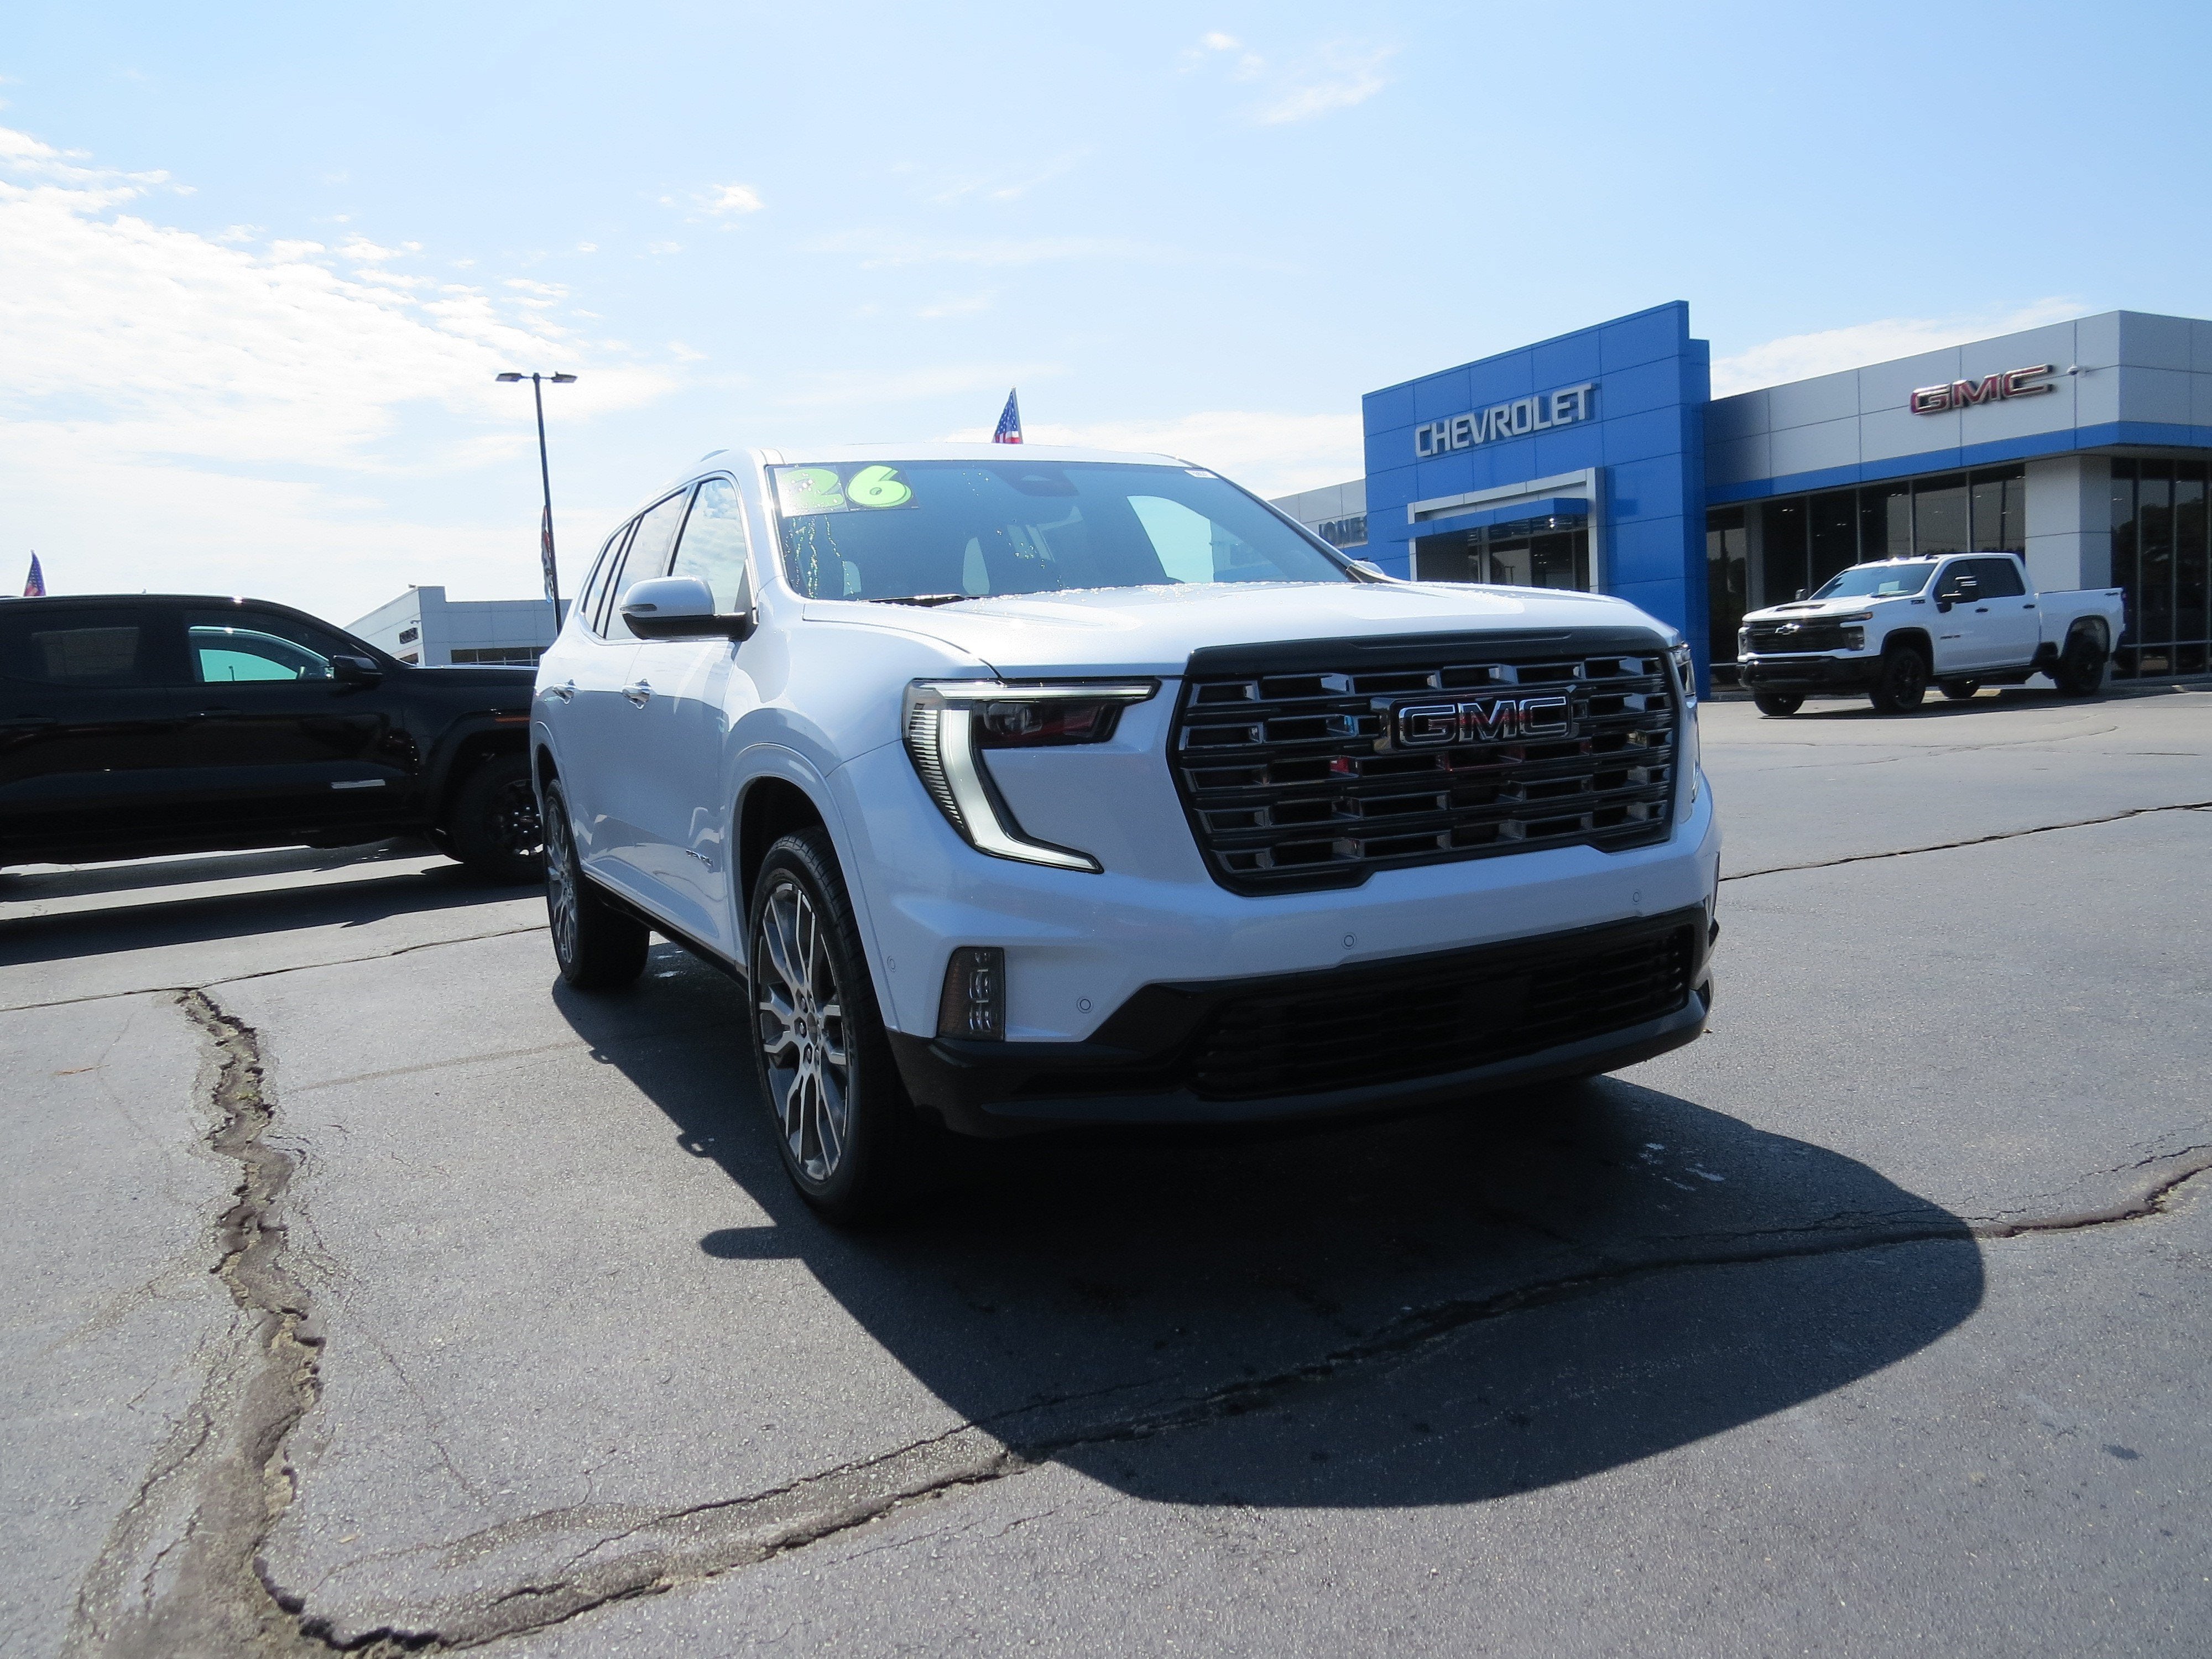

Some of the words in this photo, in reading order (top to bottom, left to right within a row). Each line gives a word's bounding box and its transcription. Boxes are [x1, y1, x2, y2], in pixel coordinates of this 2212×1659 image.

[1911, 363, 2055, 415] GMC
[1415, 383, 1593, 458] CHEVROLET
[780, 464, 914, 509] 26
[1398, 696, 1568, 745] GMC
